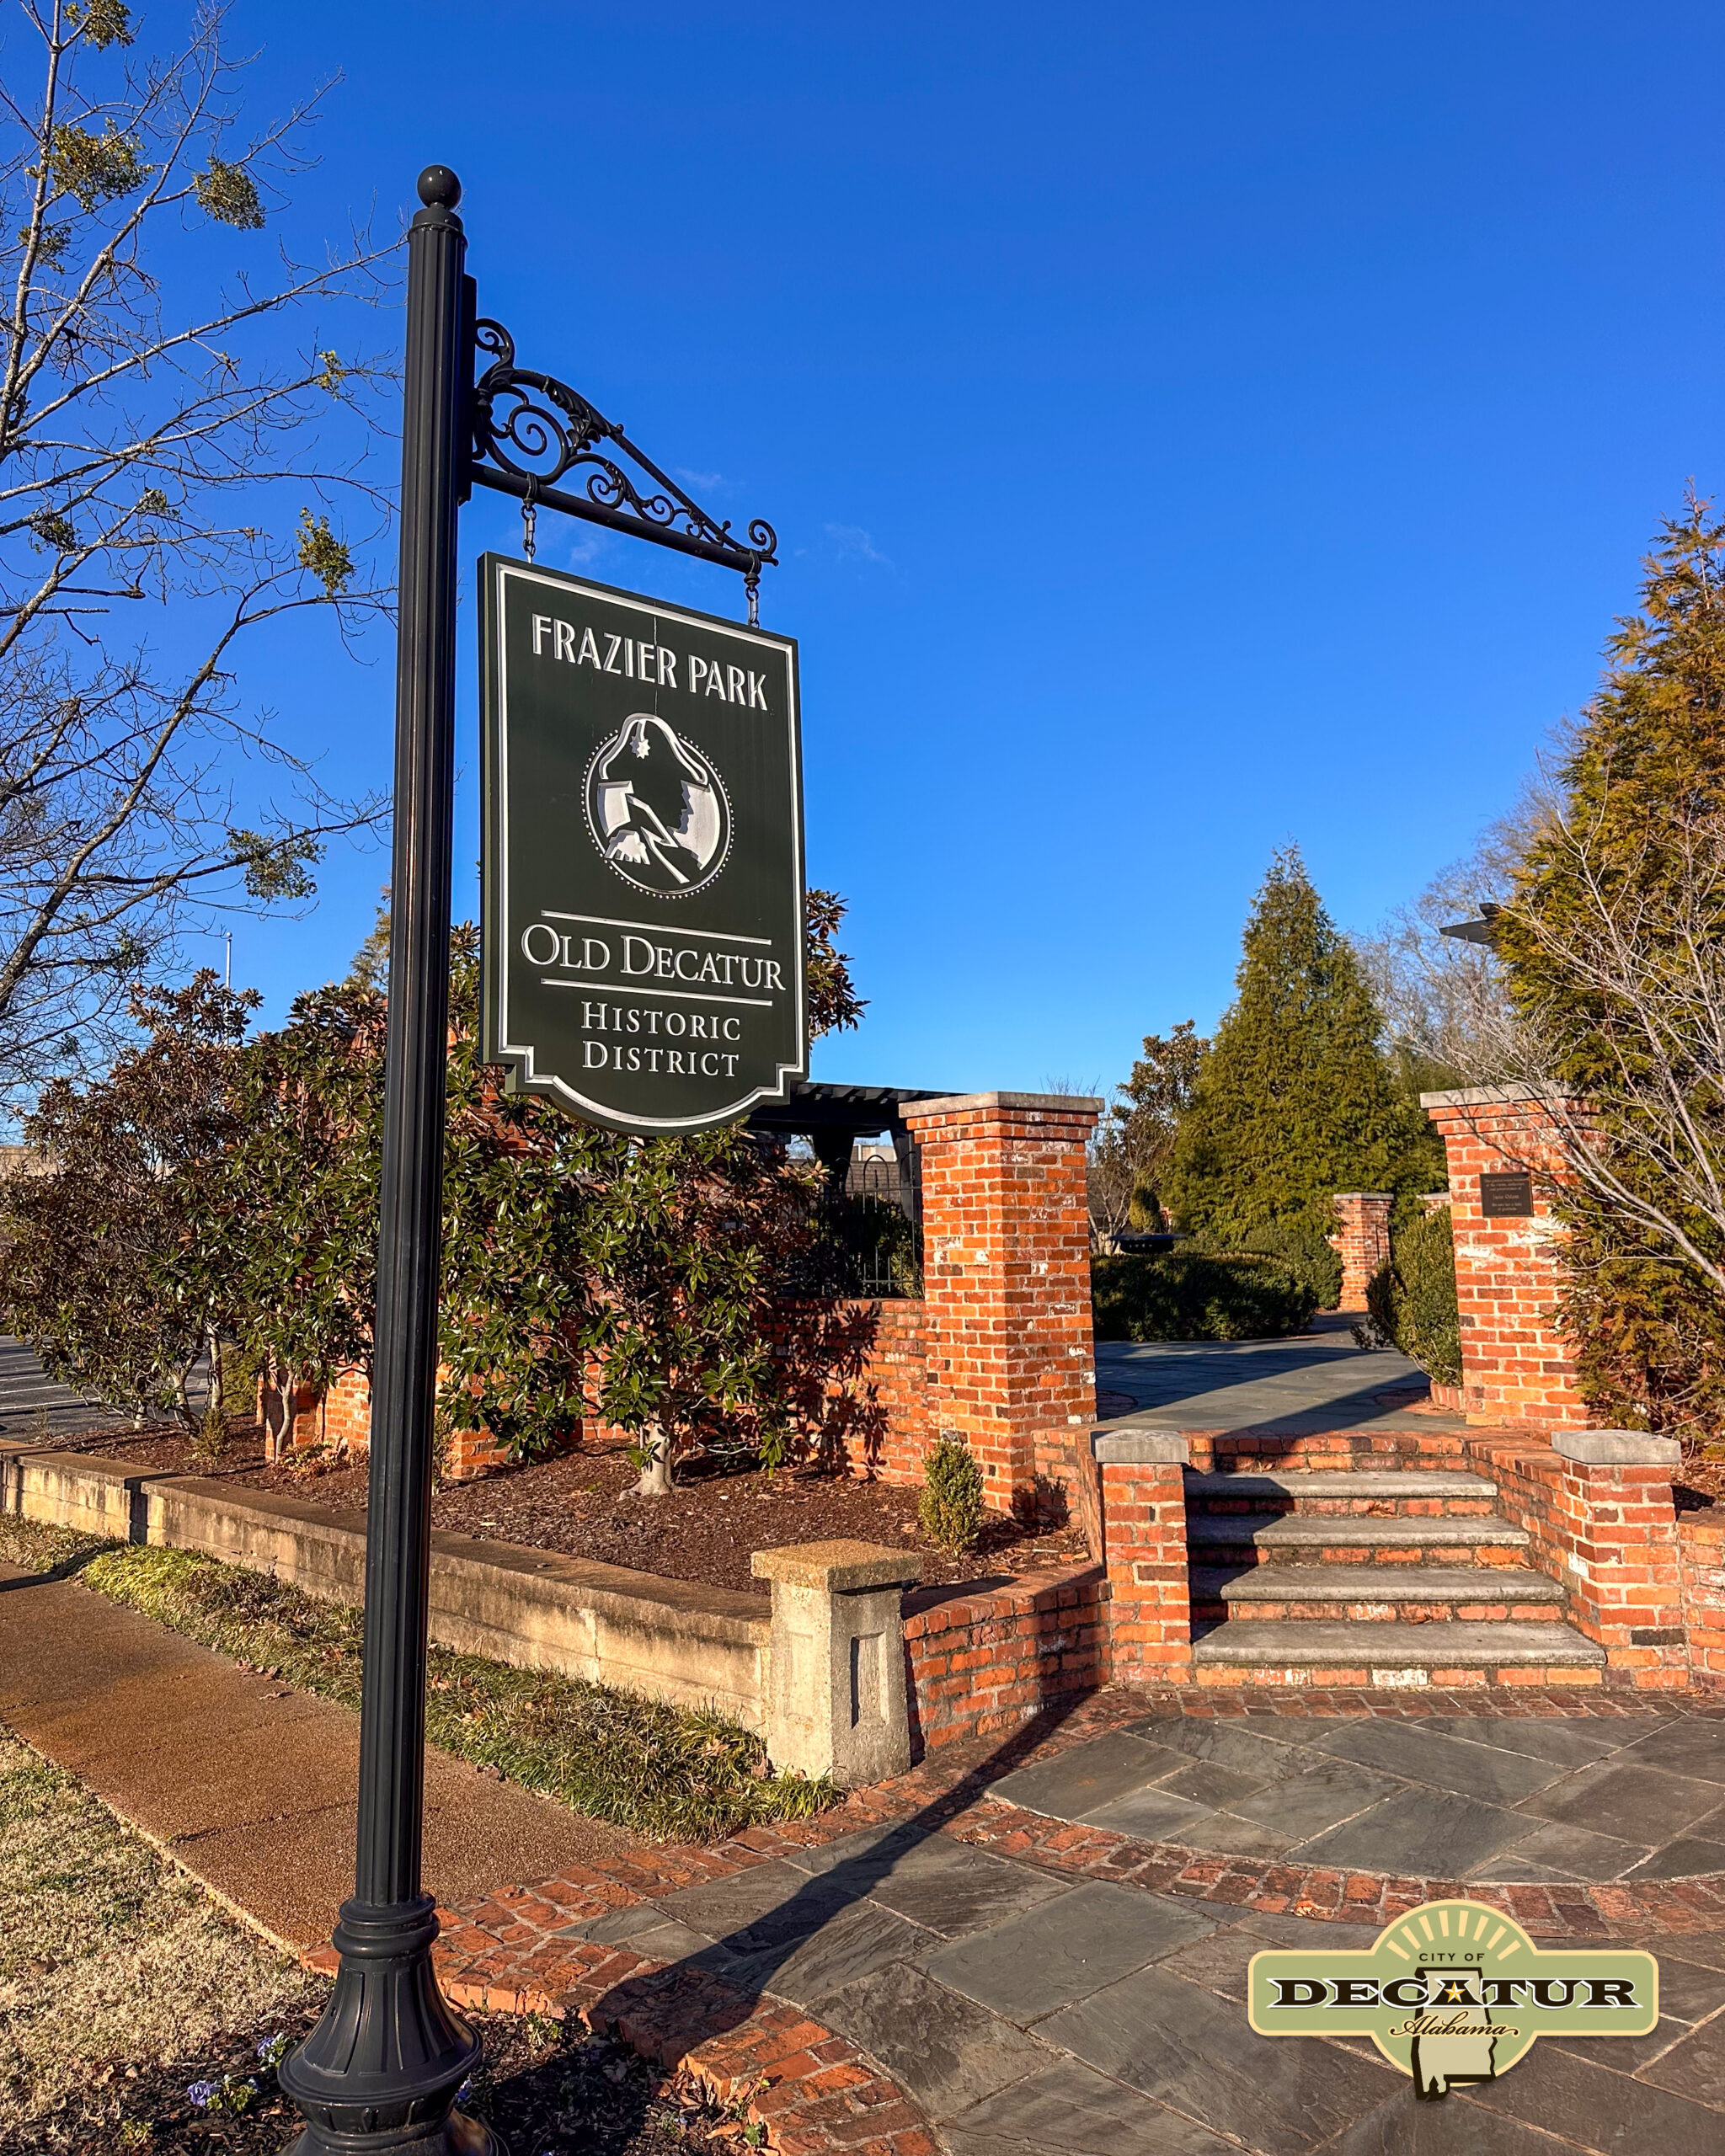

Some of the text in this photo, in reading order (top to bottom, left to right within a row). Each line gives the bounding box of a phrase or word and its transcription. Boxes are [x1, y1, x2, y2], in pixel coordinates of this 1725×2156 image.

[531, 613, 768, 711] FRAZIER PARK
[521, 924, 786, 990] OLD DECATUR
[581, 1001, 741, 1041] HISTORIC
[582, 1041, 740, 1077] DISTRICT
